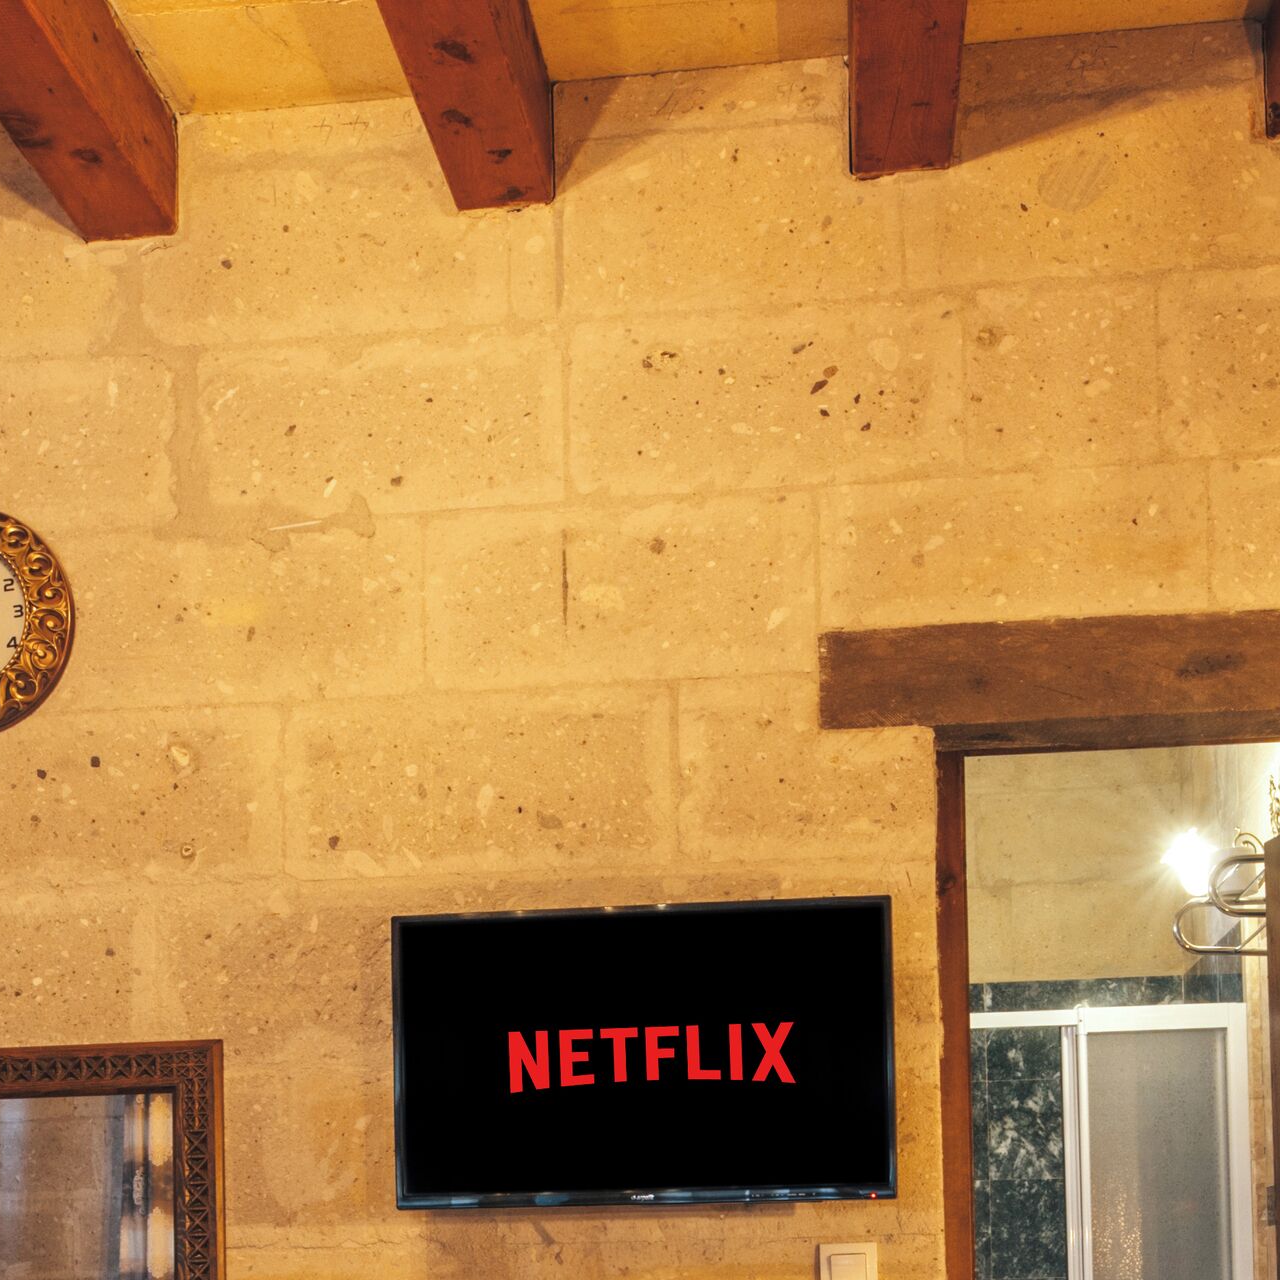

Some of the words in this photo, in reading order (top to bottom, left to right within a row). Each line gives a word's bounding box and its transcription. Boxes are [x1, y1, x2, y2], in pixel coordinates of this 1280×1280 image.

[3, 578, 15, 592] 2
[13, 604, 24, 618] 3
[6, 636, 18, 649] 4
[507, 1021, 797, 1094] NETFLIX
